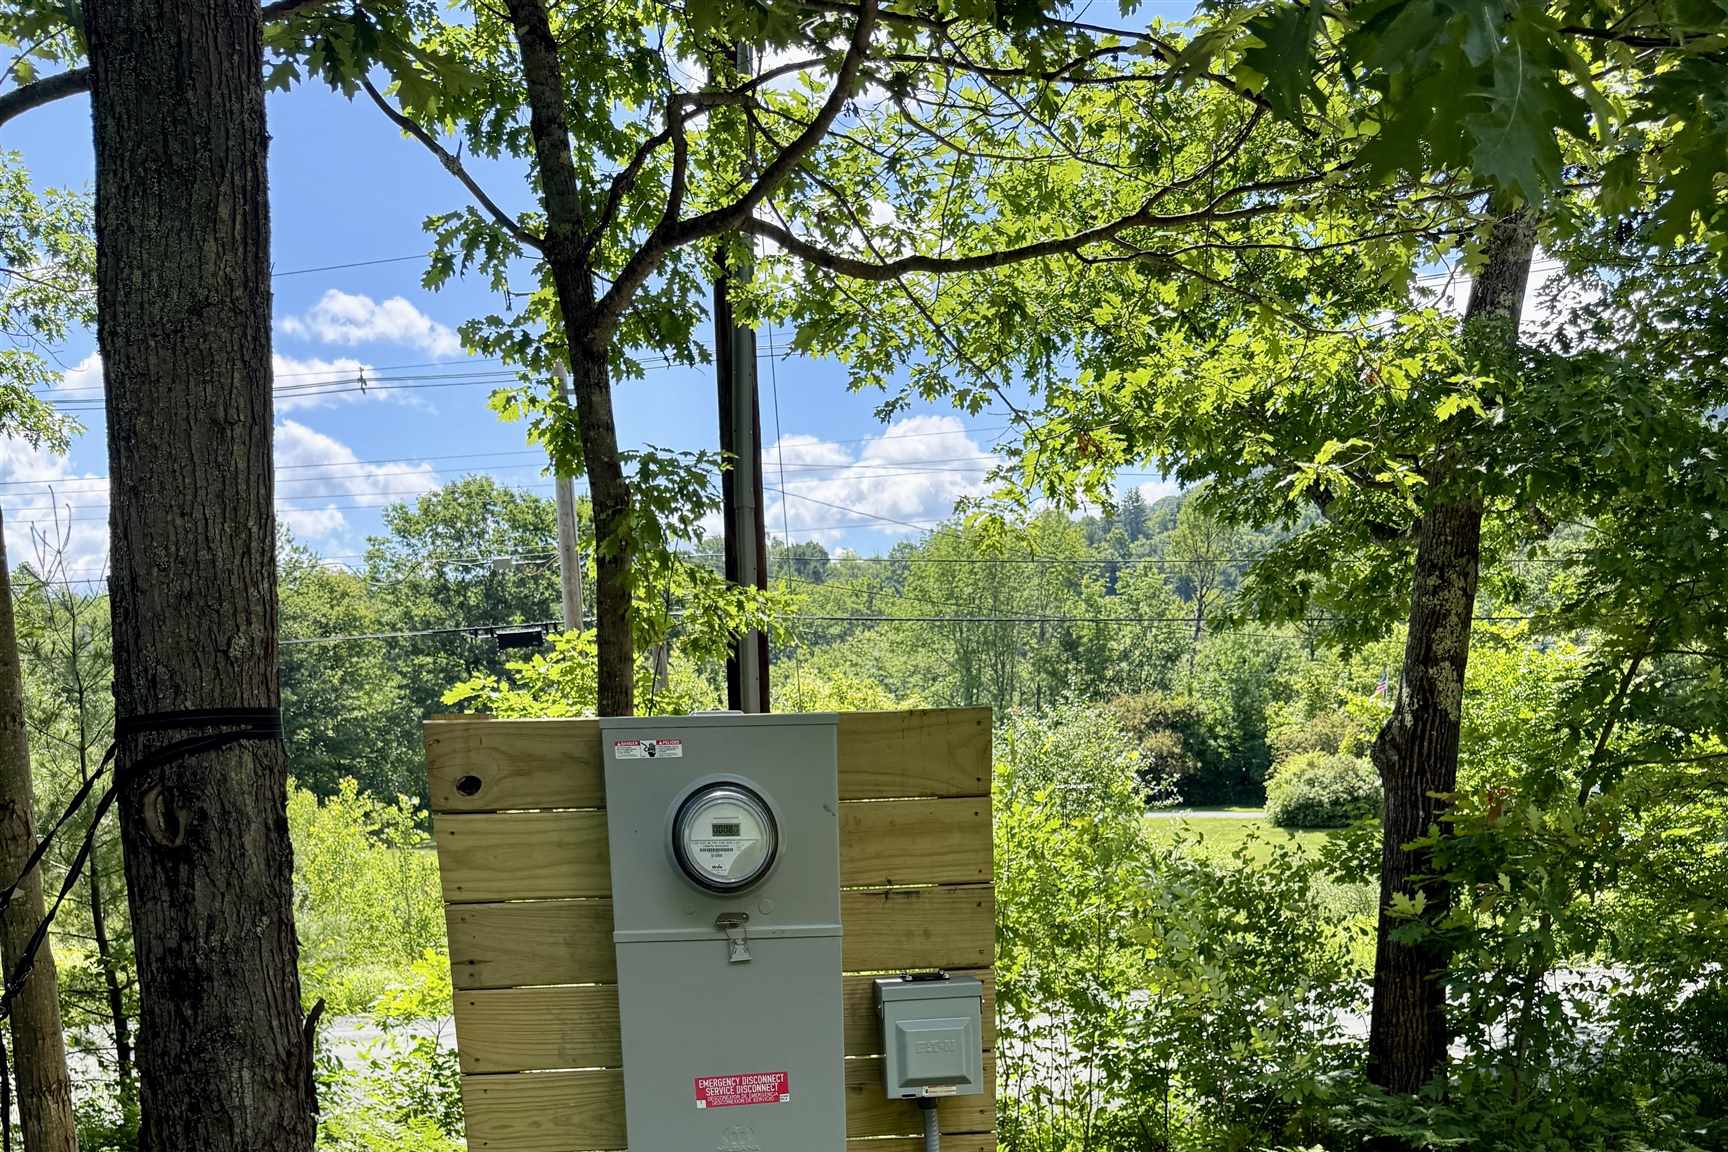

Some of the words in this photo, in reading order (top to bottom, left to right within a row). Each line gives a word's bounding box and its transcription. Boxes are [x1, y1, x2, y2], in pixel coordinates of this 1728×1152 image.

[698, 1078, 740, 1088] EMERGENCY
[742, 1074, 784, 1084] DISCONNECT
[705, 1086, 735, 1096] SERVICE
[736, 1083, 778, 1094] DISCONNECT
